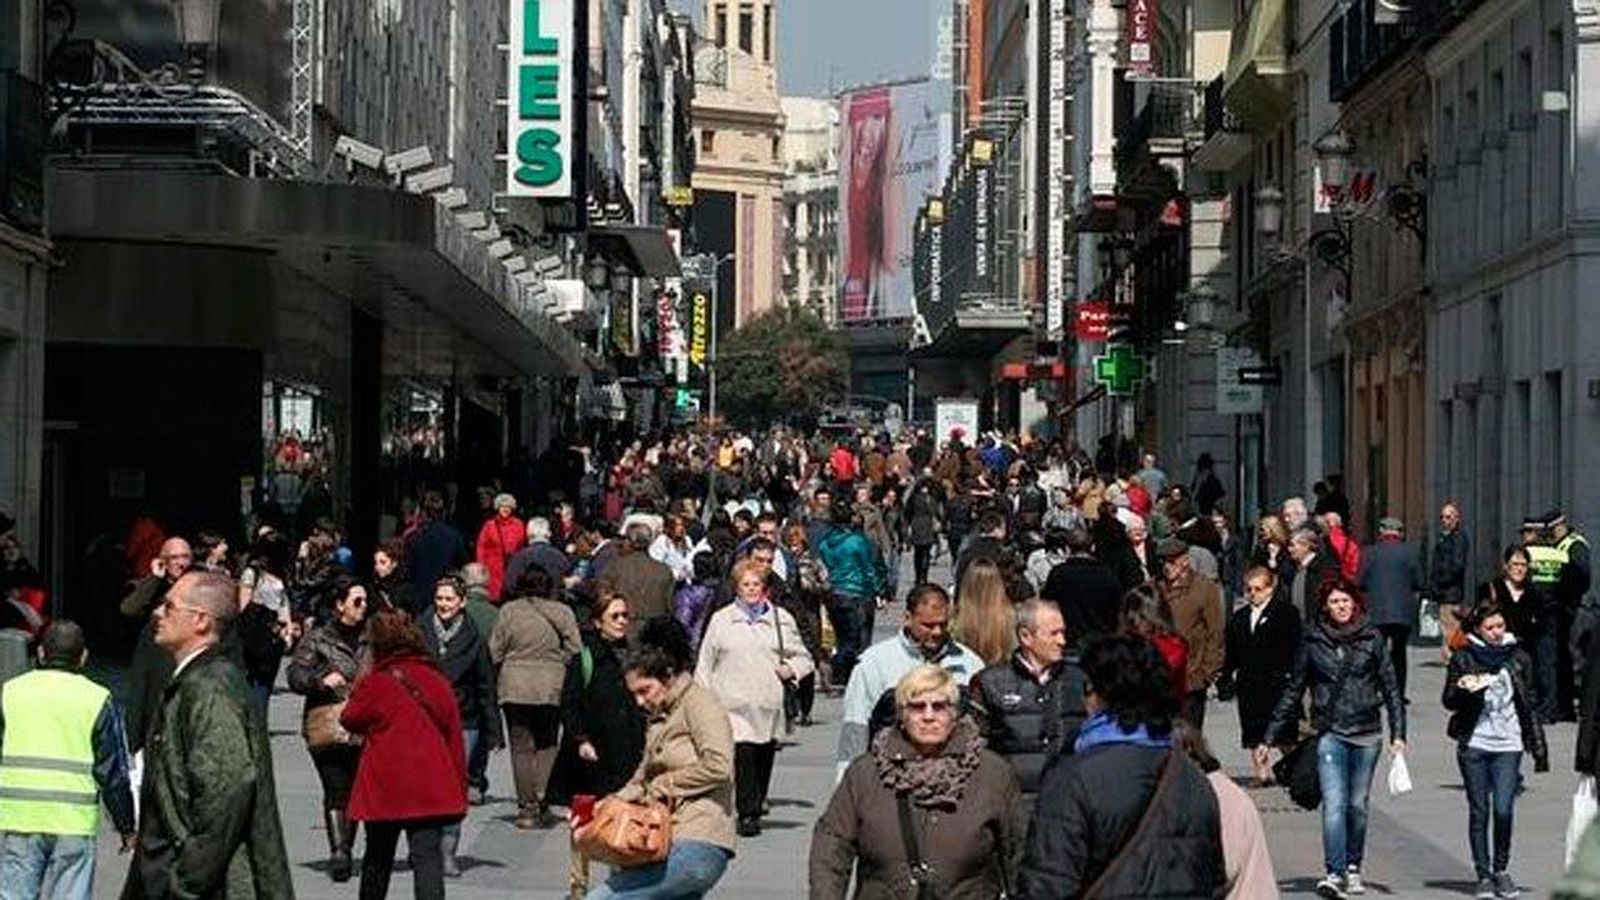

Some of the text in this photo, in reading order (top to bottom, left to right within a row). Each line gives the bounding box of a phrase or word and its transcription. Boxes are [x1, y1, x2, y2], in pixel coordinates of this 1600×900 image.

[975, 169, 987, 276] VENTA DE ENTRADAS
[930, 226, 942, 302] INFORMÁTICA
[689, 294, 706, 371] Atrezzo
